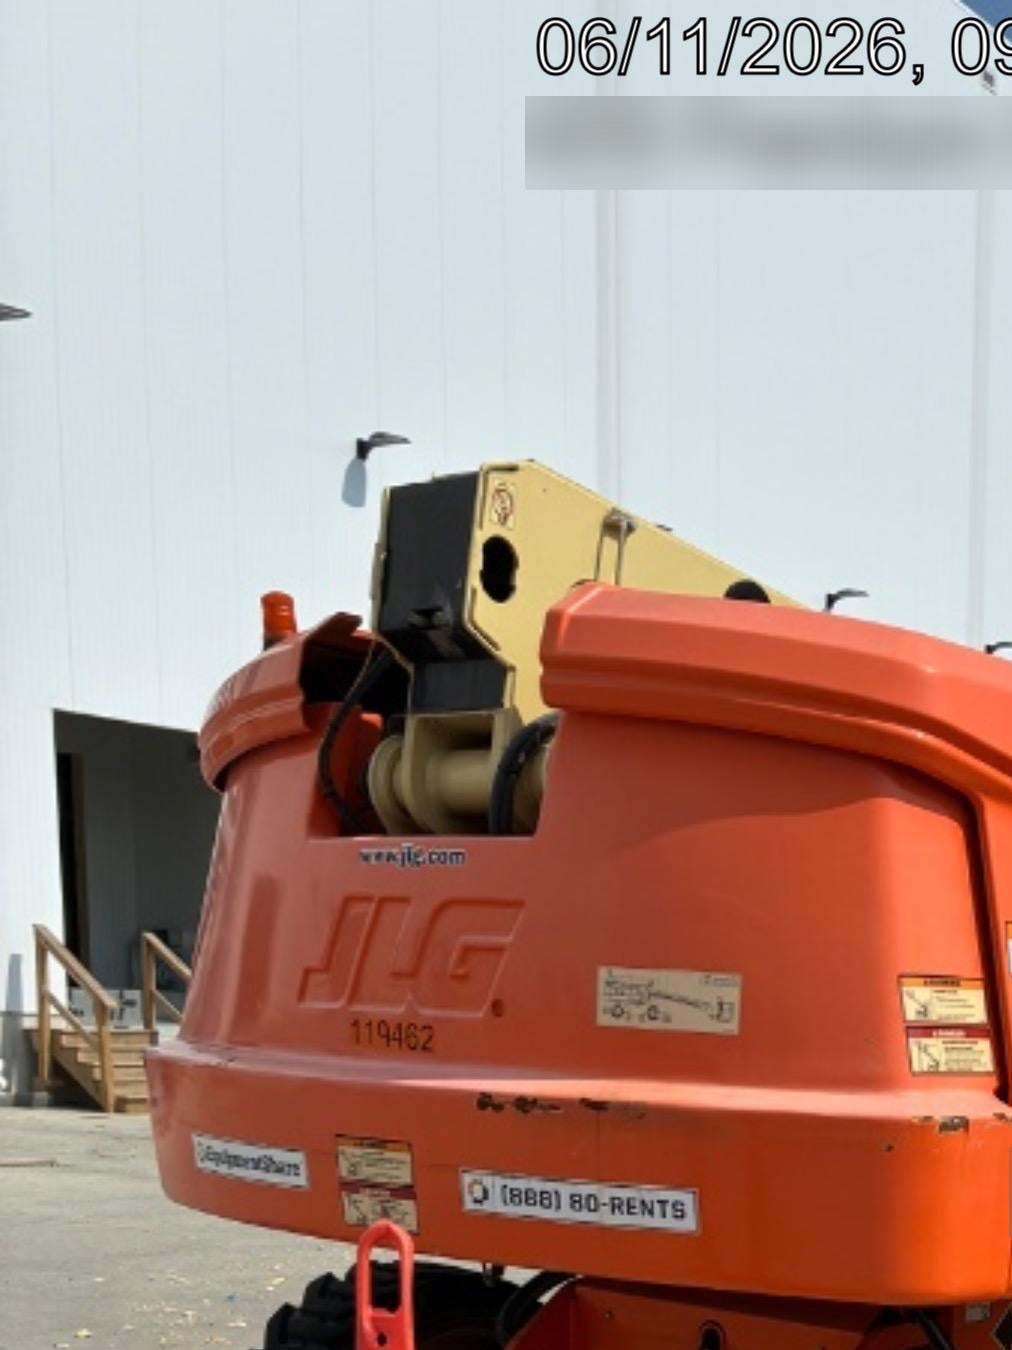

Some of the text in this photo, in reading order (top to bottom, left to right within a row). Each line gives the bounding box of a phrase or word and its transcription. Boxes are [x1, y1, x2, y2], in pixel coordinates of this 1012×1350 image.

[297, 896, 527, 1018] JLG
[351, 1018, 435, 1052] 119462
[500, 1183, 688, 1221] (888) 80-RENTS
